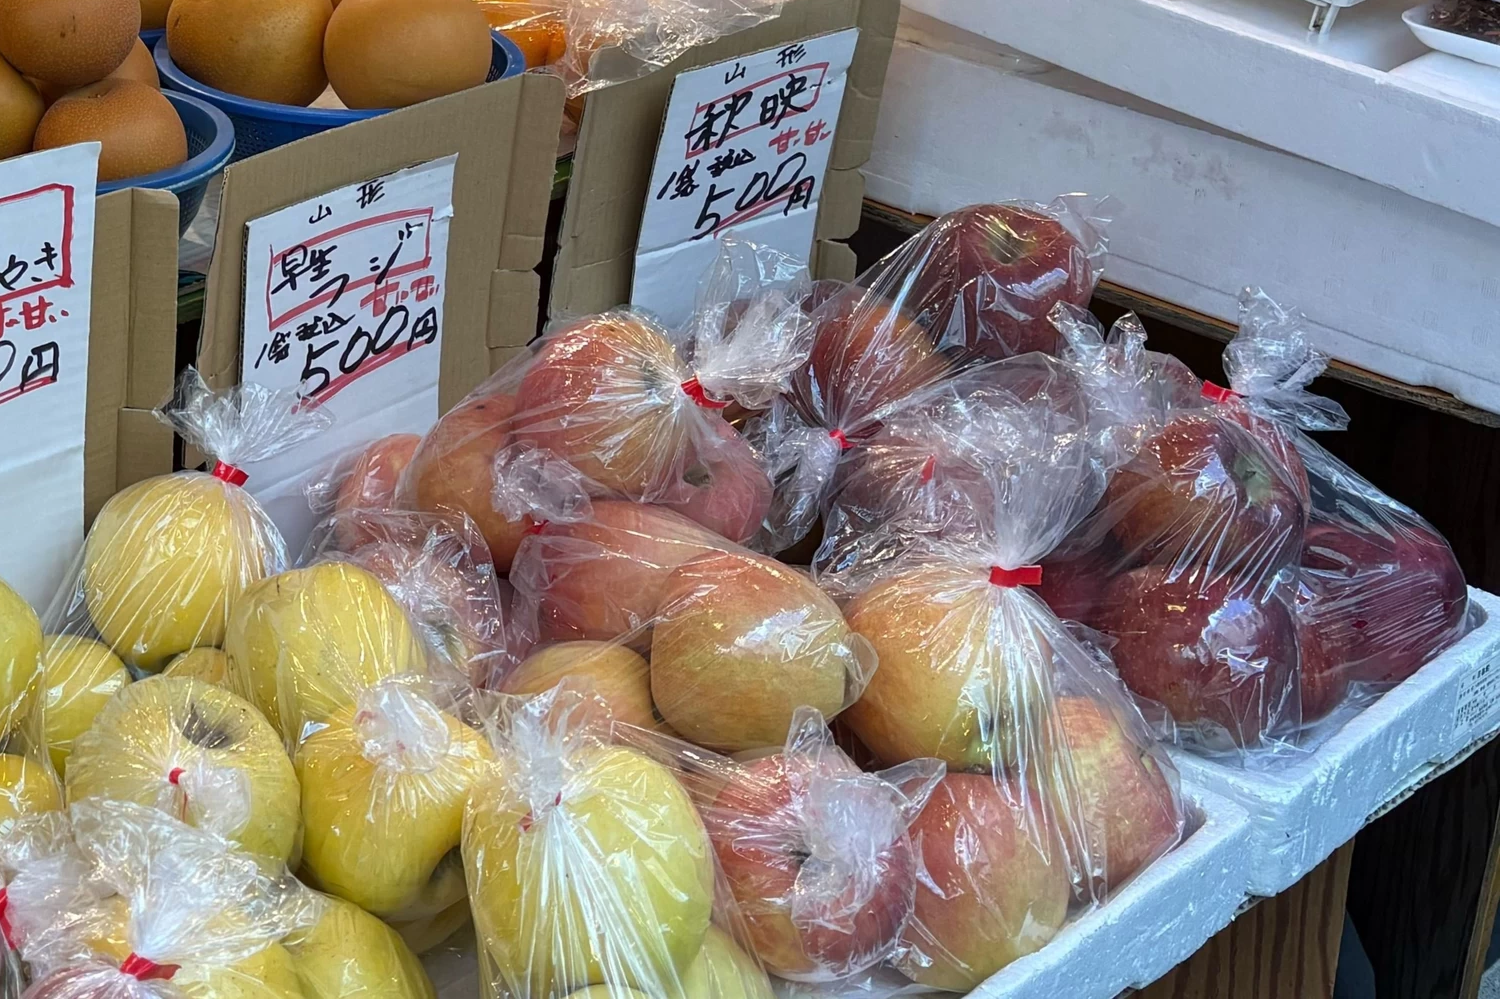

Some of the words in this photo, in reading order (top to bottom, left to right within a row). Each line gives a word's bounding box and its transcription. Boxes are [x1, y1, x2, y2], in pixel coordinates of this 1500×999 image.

[725, 44, 807, 85] 山形
[684, 73, 808, 150] 秋映
[308, 179, 386, 224] 山形
[688, 151, 816, 241] 500円
[297, 305, 438, 400] 500円
